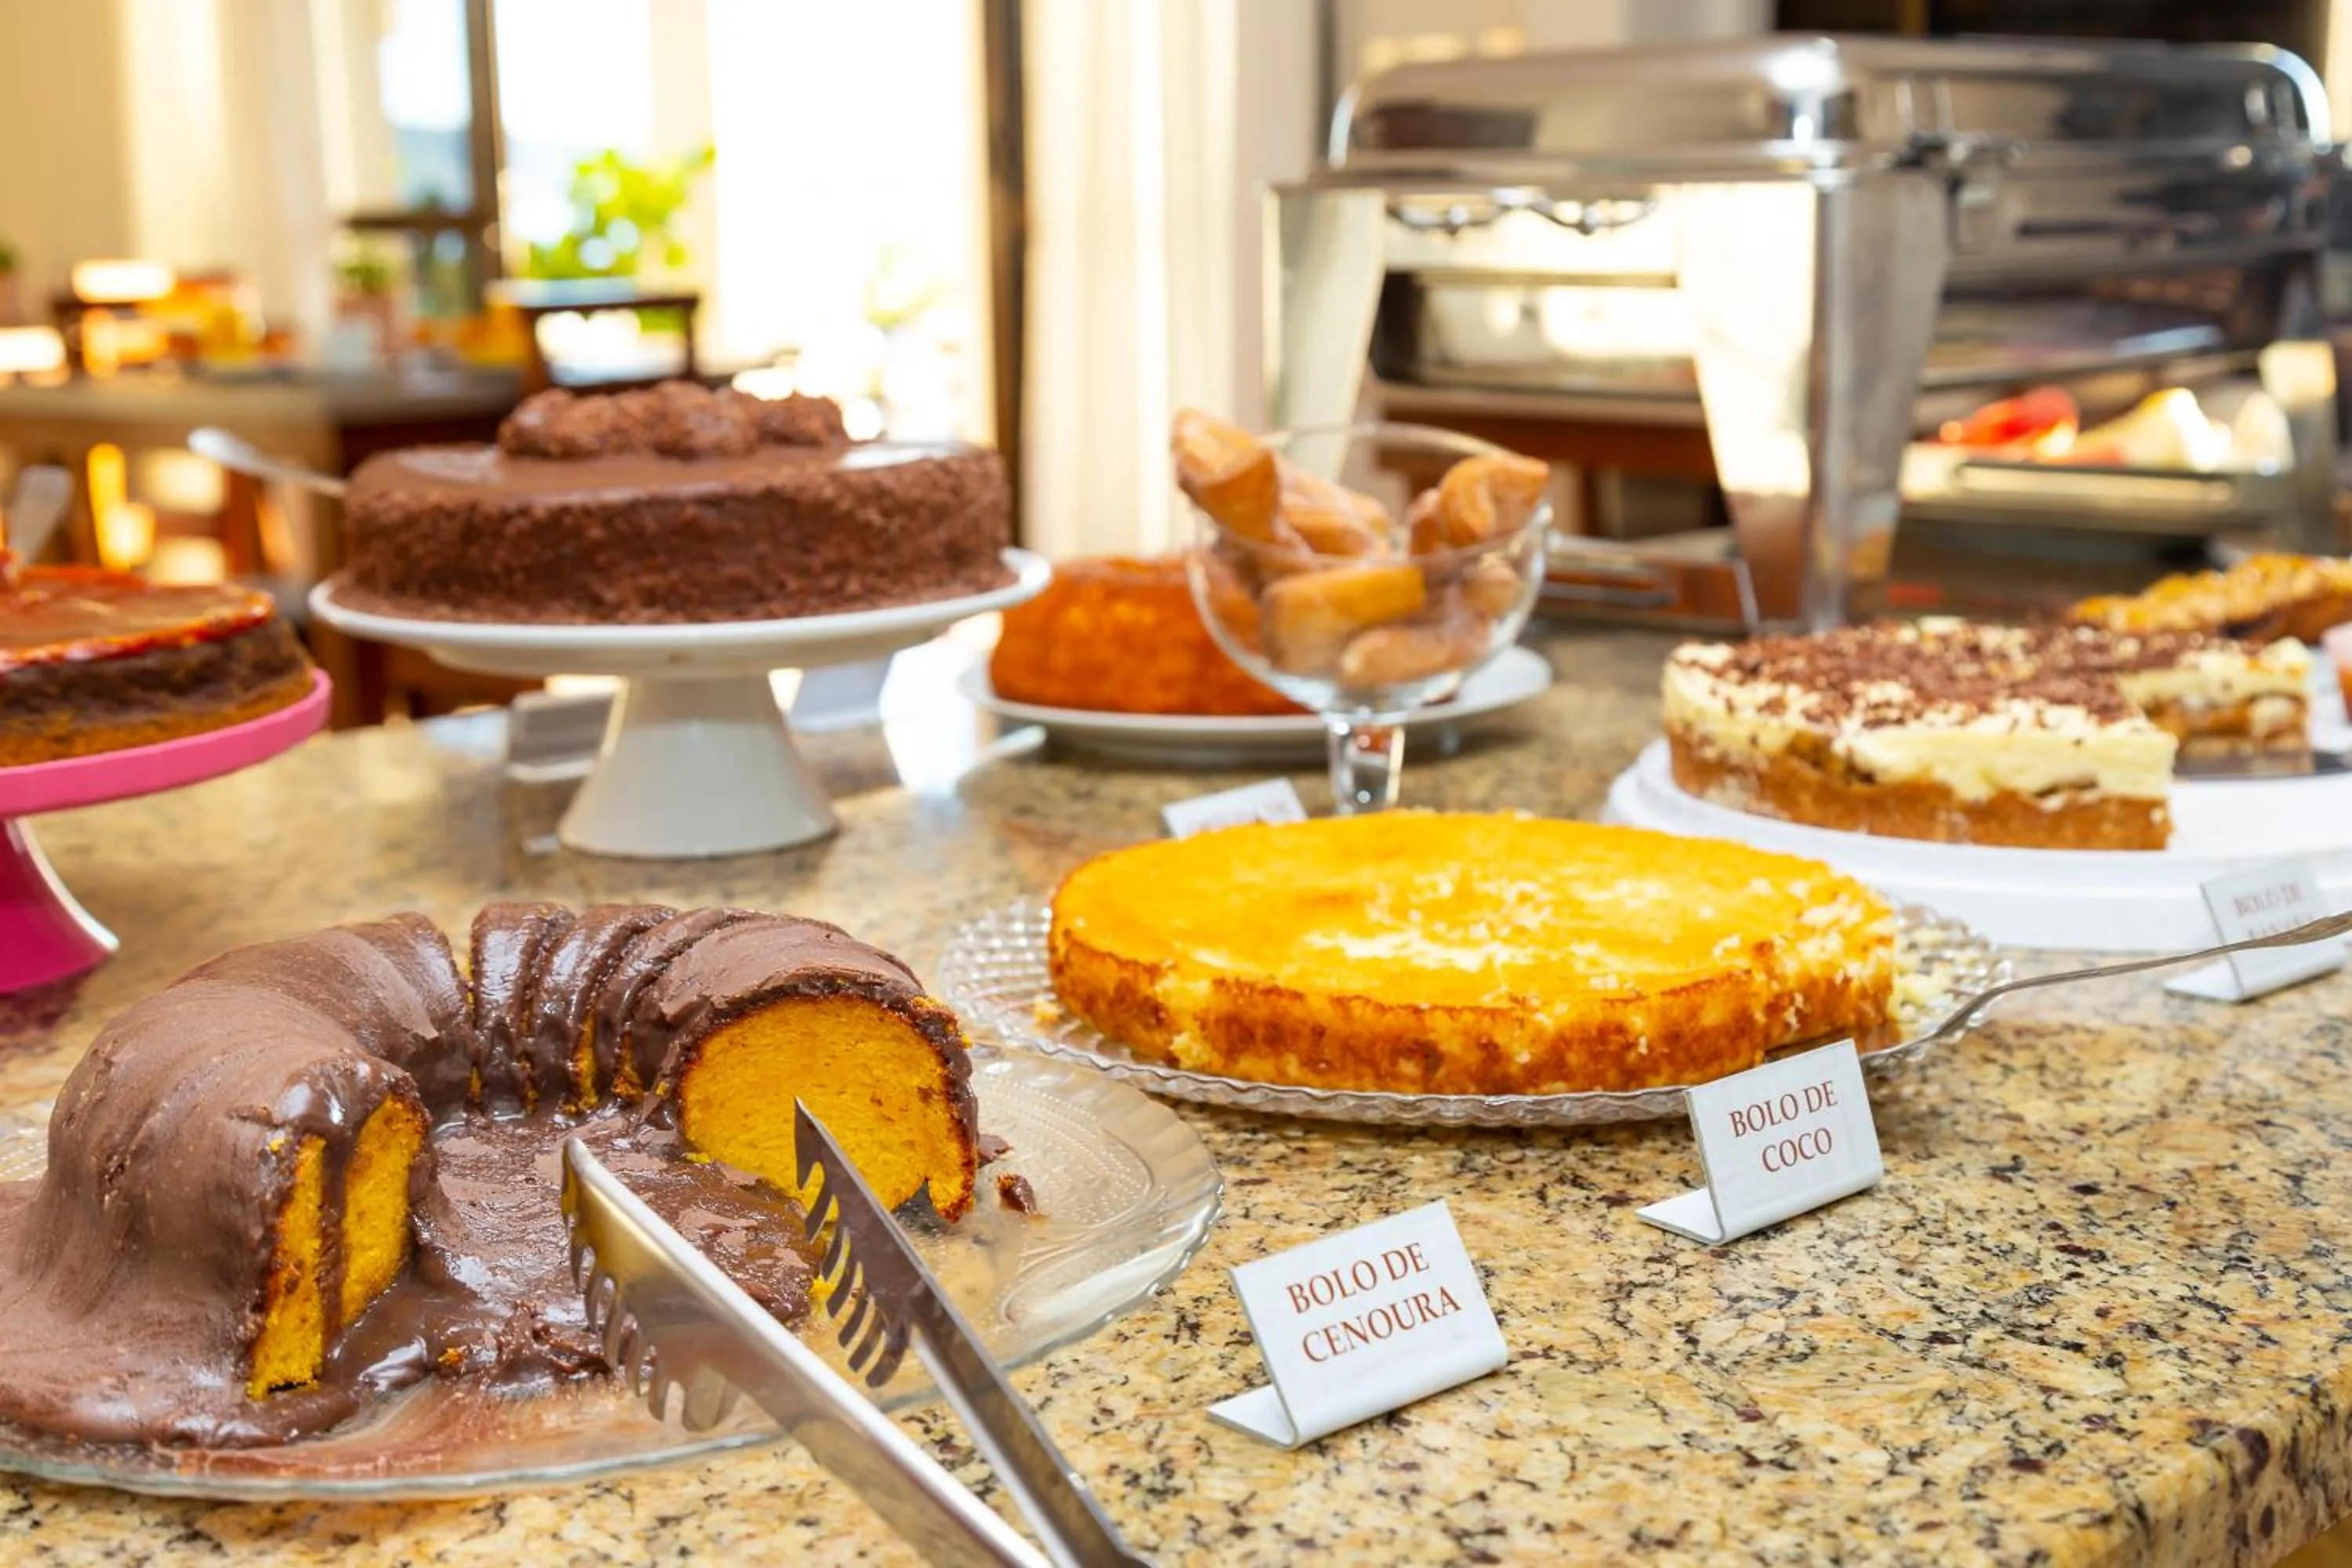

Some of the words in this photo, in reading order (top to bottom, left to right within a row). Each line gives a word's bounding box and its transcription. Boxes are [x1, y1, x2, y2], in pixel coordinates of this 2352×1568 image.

[1728, 1094, 1799, 1138] BOLO
[1802, 1080, 1838, 1114] DE
[1762, 1127, 1833, 1172] COCO
[1286, 1260, 1378, 1315] BOLO
[1381, 1242, 1430, 1282] DE
[1302, 1286, 1462, 1363] CENOURA
